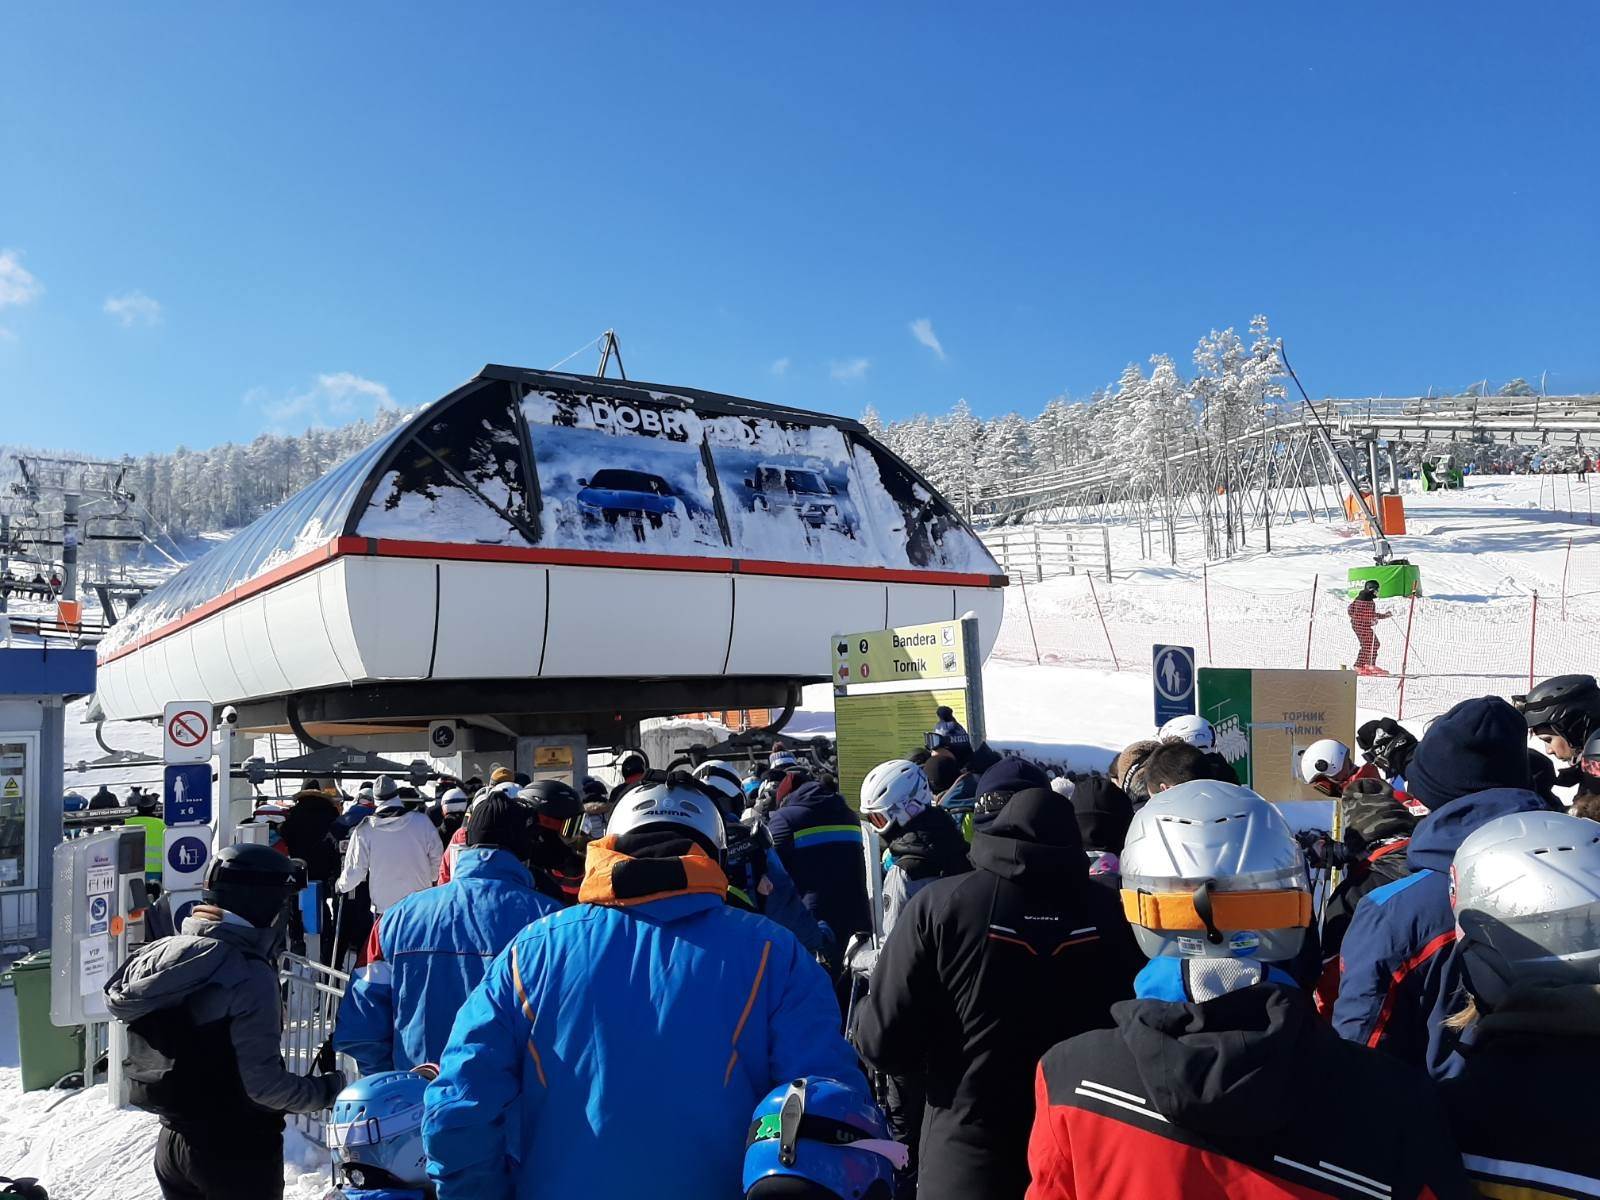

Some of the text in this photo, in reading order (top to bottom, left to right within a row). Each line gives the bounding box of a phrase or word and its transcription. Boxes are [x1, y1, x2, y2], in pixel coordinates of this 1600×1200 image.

[892, 634, 936, 648] Bandera
[893, 658, 927, 673] Tornik
[1281, 711, 1325, 721] ТОРНИК
